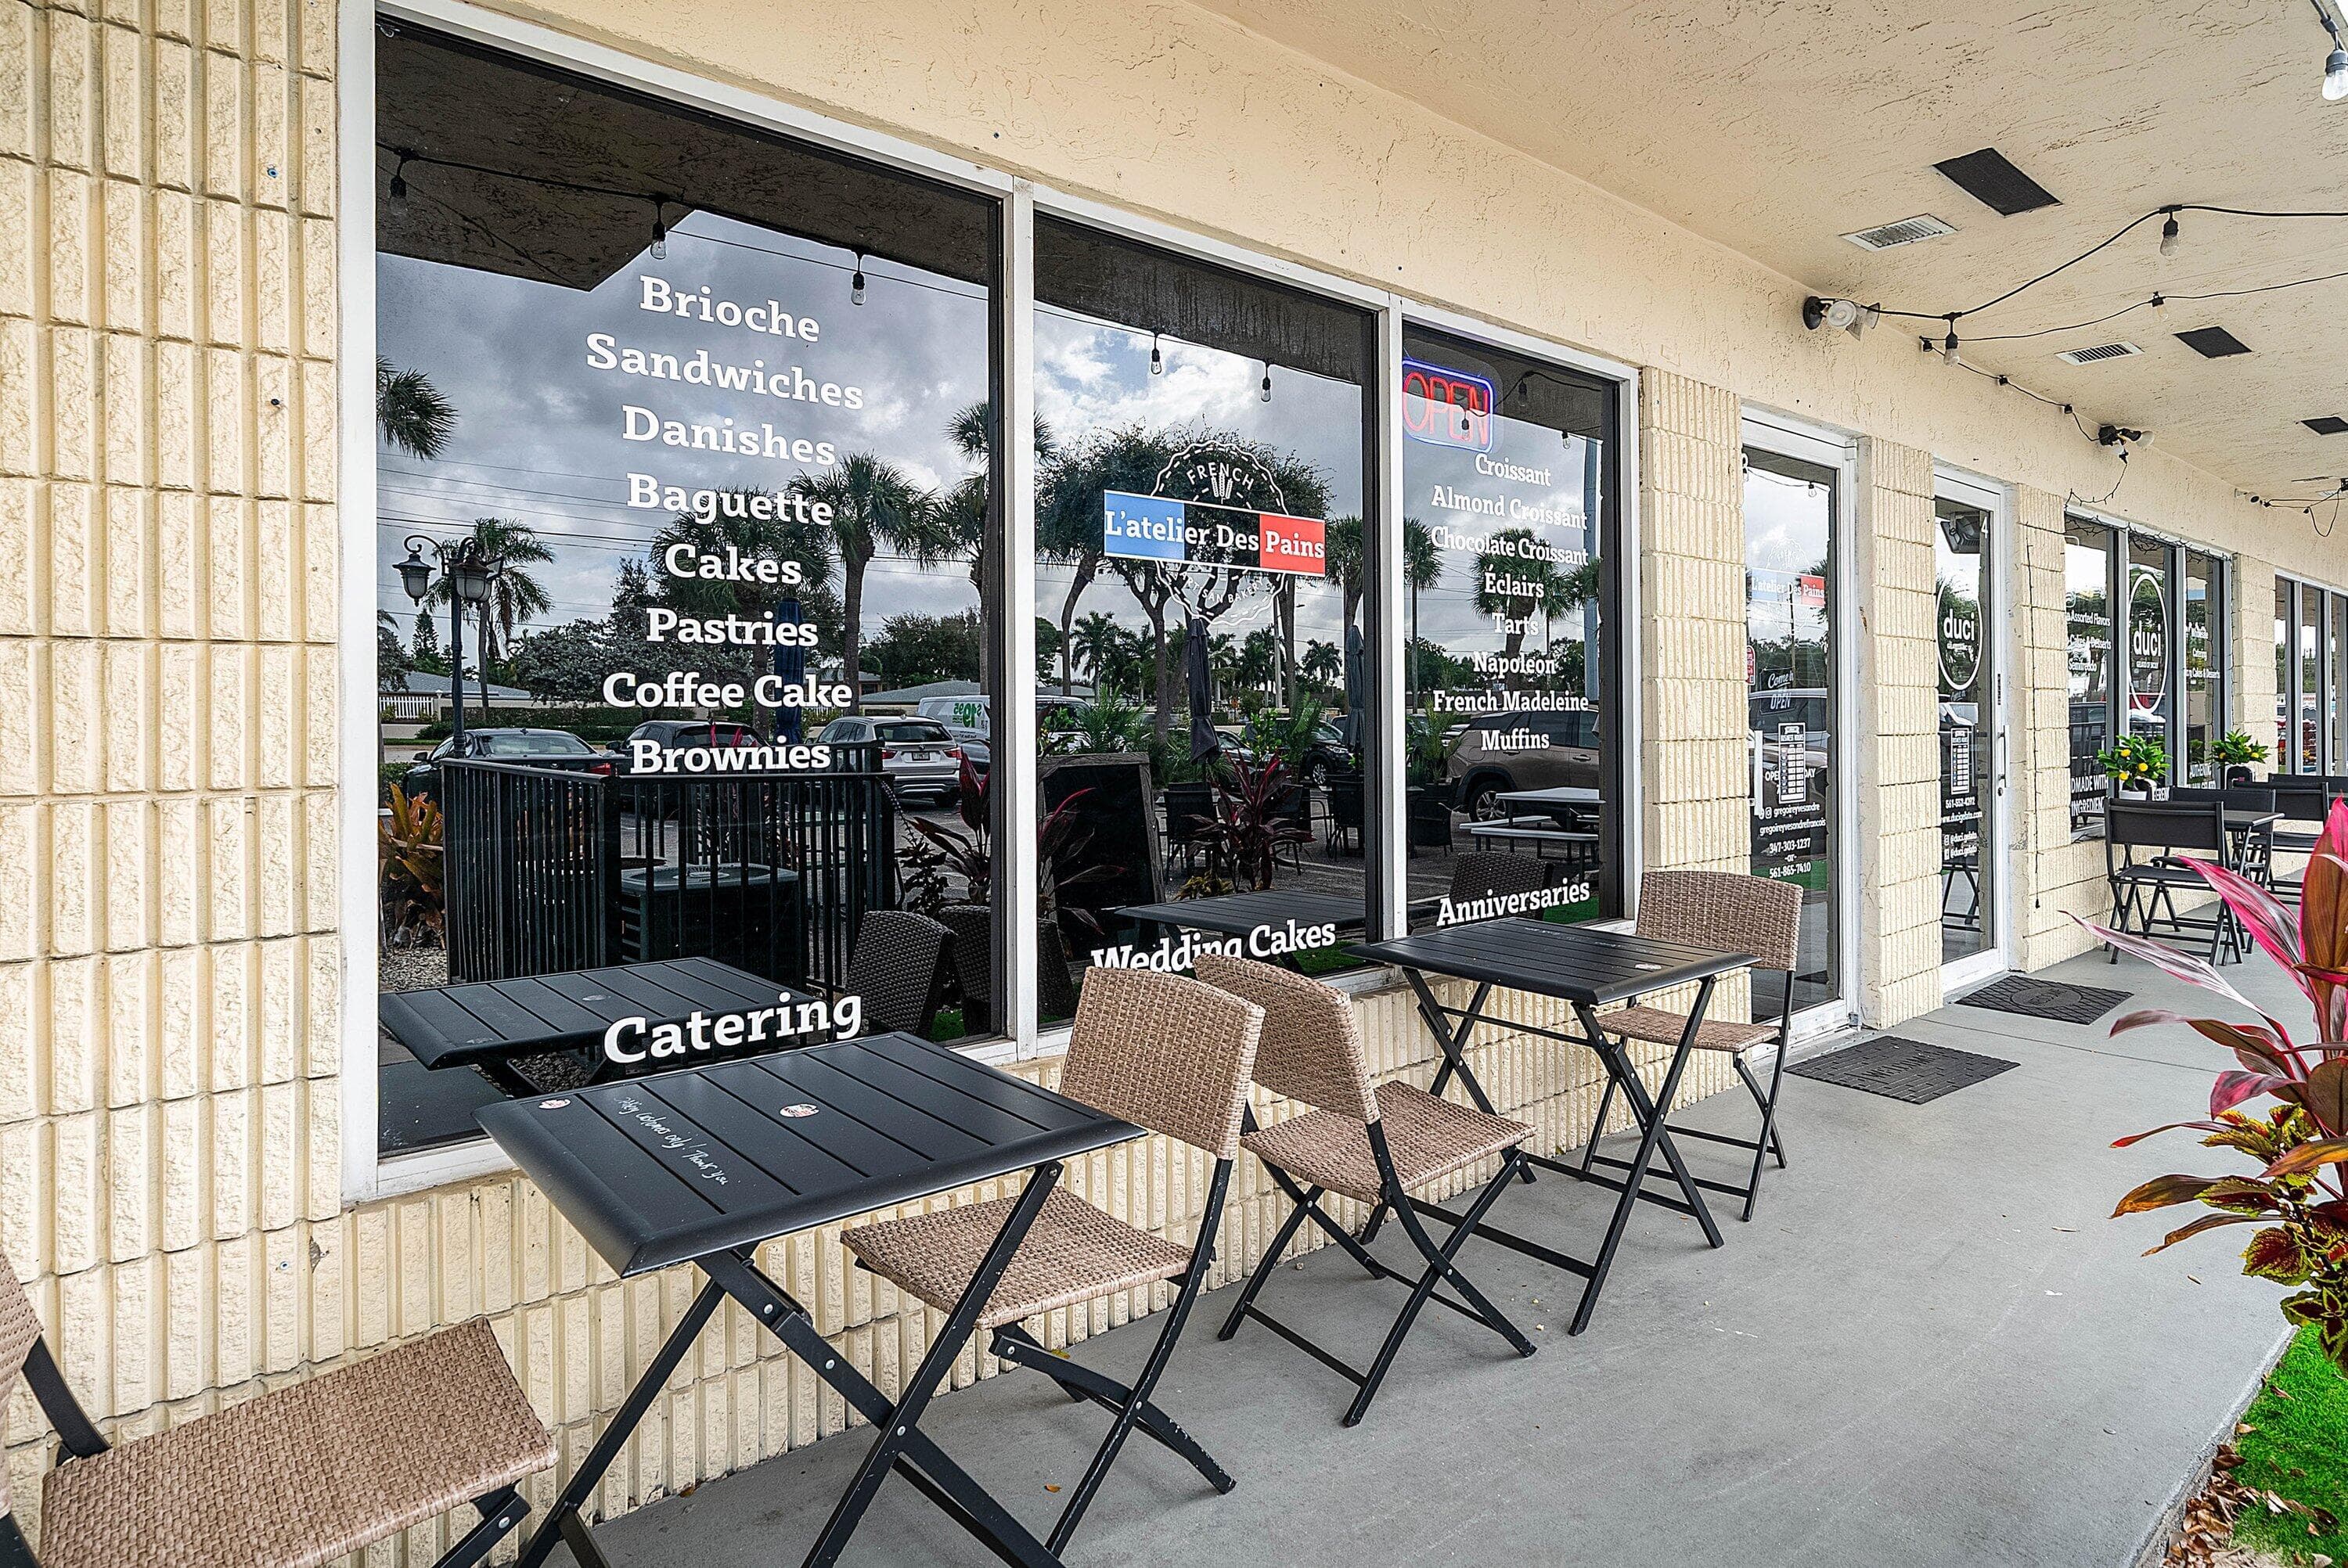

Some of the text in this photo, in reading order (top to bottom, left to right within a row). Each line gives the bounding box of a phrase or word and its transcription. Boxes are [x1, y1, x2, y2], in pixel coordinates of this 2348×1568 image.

[639, 274, 820, 343] Brioche
[585, 333, 864, 410] Sandwiches
[1403, 372, 1488, 445] OPEN
[621, 404, 837, 466] Danishes
[1186, 462, 1254, 491] FRENCH
[1475, 453, 1551, 487] Croissant
[626, 472, 834, 526] Baguette
[1431, 484, 1588, 530] Almond Croissant
[1215, 523, 1259, 552] Des
[1265, 530, 1325, 559] Pains
[1981, 516, 1989, 539] 4
[1431, 525, 1589, 566] Chocolate Croissant
[664, 543, 802, 585] Cakes
[1484, 563, 1545, 599] Éclairs
[1227, 576, 1265, 603] BAKERY
[1787, 584, 1802, 596] Des
[1802, 584, 1824, 599] Pains
[645, 607, 819, 647] Pastries
[1491, 612, 1540, 636] Tarts
[1943, 608, 1975, 641] duci
[2071, 610, 2094, 624] Assorted
[2094, 613, 2111, 627] Flavors
[2134, 619, 2161, 656] duci
[1473, 651, 1557, 679] Napoleon
[1768, 673, 1788, 689] Come
[603, 671, 853, 708] Coffee Cake
[1432, 689, 1589, 712] French Madeleine
[1770, 692, 1792, 710] OPEN
[628, 735, 831, 775] Brownies
[1481, 728, 1550, 751] Muffins
[1764, 770, 1780, 782] OPE
[2094, 774, 2109, 789] WITH
[1769, 838, 1811, 854] 347-303-1237
[1769, 862, 1811, 879] 561-865-7410
[1436, 877, 1590, 927] Anniversaries
[1090, 918, 1337, 973] Wedding Cakes
[603, 991, 862, 1064] Catering
[682, 1149, 718, 1171] Thank
